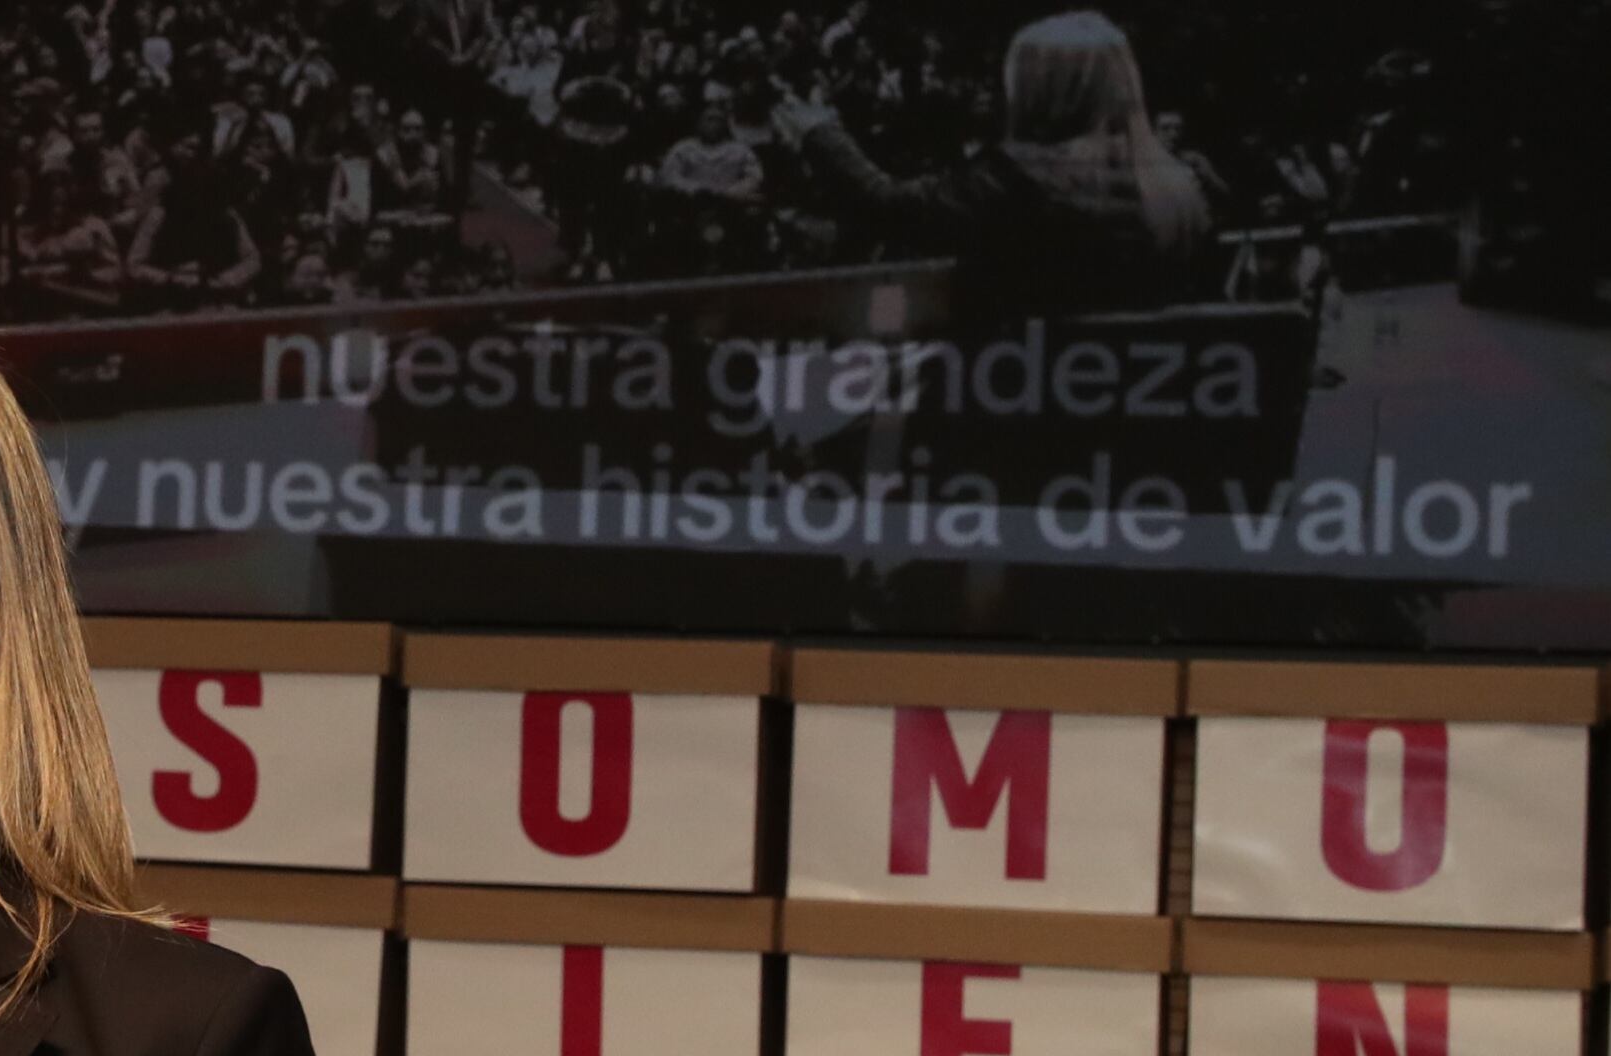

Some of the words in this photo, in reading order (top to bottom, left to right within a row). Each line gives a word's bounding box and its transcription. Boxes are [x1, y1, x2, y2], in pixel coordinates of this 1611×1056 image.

[260, 320, 676, 411] nuestra
[705, 318, 1261, 439] grandeza
[135, 444, 545, 539] nuestra
[577, 442, 1003, 548] historia
[1035, 449, 1190, 553] de
[1222, 453, 1534, 560] valor
